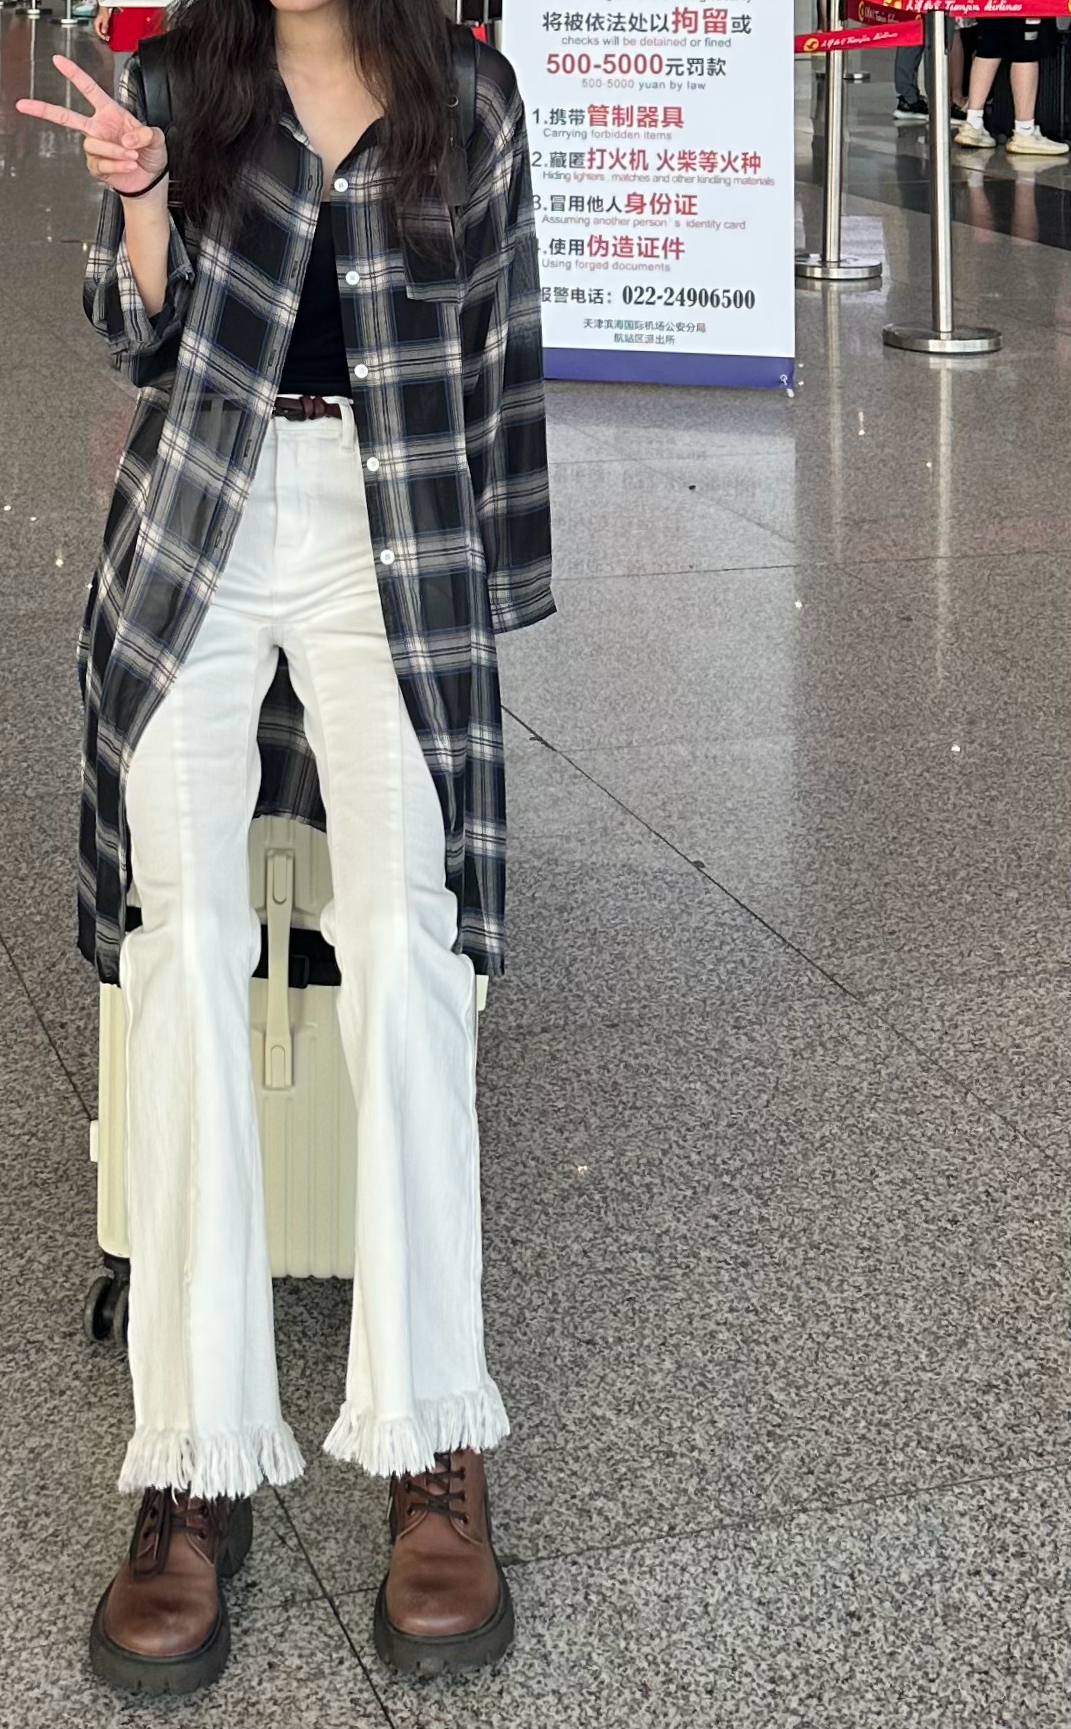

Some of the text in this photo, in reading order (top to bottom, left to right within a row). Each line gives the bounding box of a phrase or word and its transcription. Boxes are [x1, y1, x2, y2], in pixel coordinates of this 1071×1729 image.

[944, 0, 980, 15] Tianjin
[542, 6, 753, 35] 将被依法处以拘留或
[561, 36, 731, 48] checks will be detained or fined
[546, 53, 727, 77] 500-5000元罚款
[581, 78, 706, 92] 500-5000 yuan by law
[531, 103, 684, 129] 1.携带管制器具
[543, 128, 672, 140] Carrying forbidden items
[531, 146, 762, 175] 2.藏匿打火机 火柴等火种
[542, 171, 572, 183] Hiding
[612, 173, 651, 183] matches
[652, 173, 670, 183] and
[671, 174, 695, 183] other
[697, 175, 732, 186] kindling
[733, 176, 776, 186] materials
[532, 191, 699, 216] 3.冒用他人身份证
[542, 214, 590, 226] Assuming
[593, 216, 630, 226] another
[686, 218, 721, 230] identity
[724, 219, 746, 229] card
[538, 234, 686, 260] .使用伪造证件
[542, 259, 671, 272] Using forged documents
[622, 285, 756, 309] 022-24906500
[583, 318, 707, 333] 天津滨海国际机场公安分局
